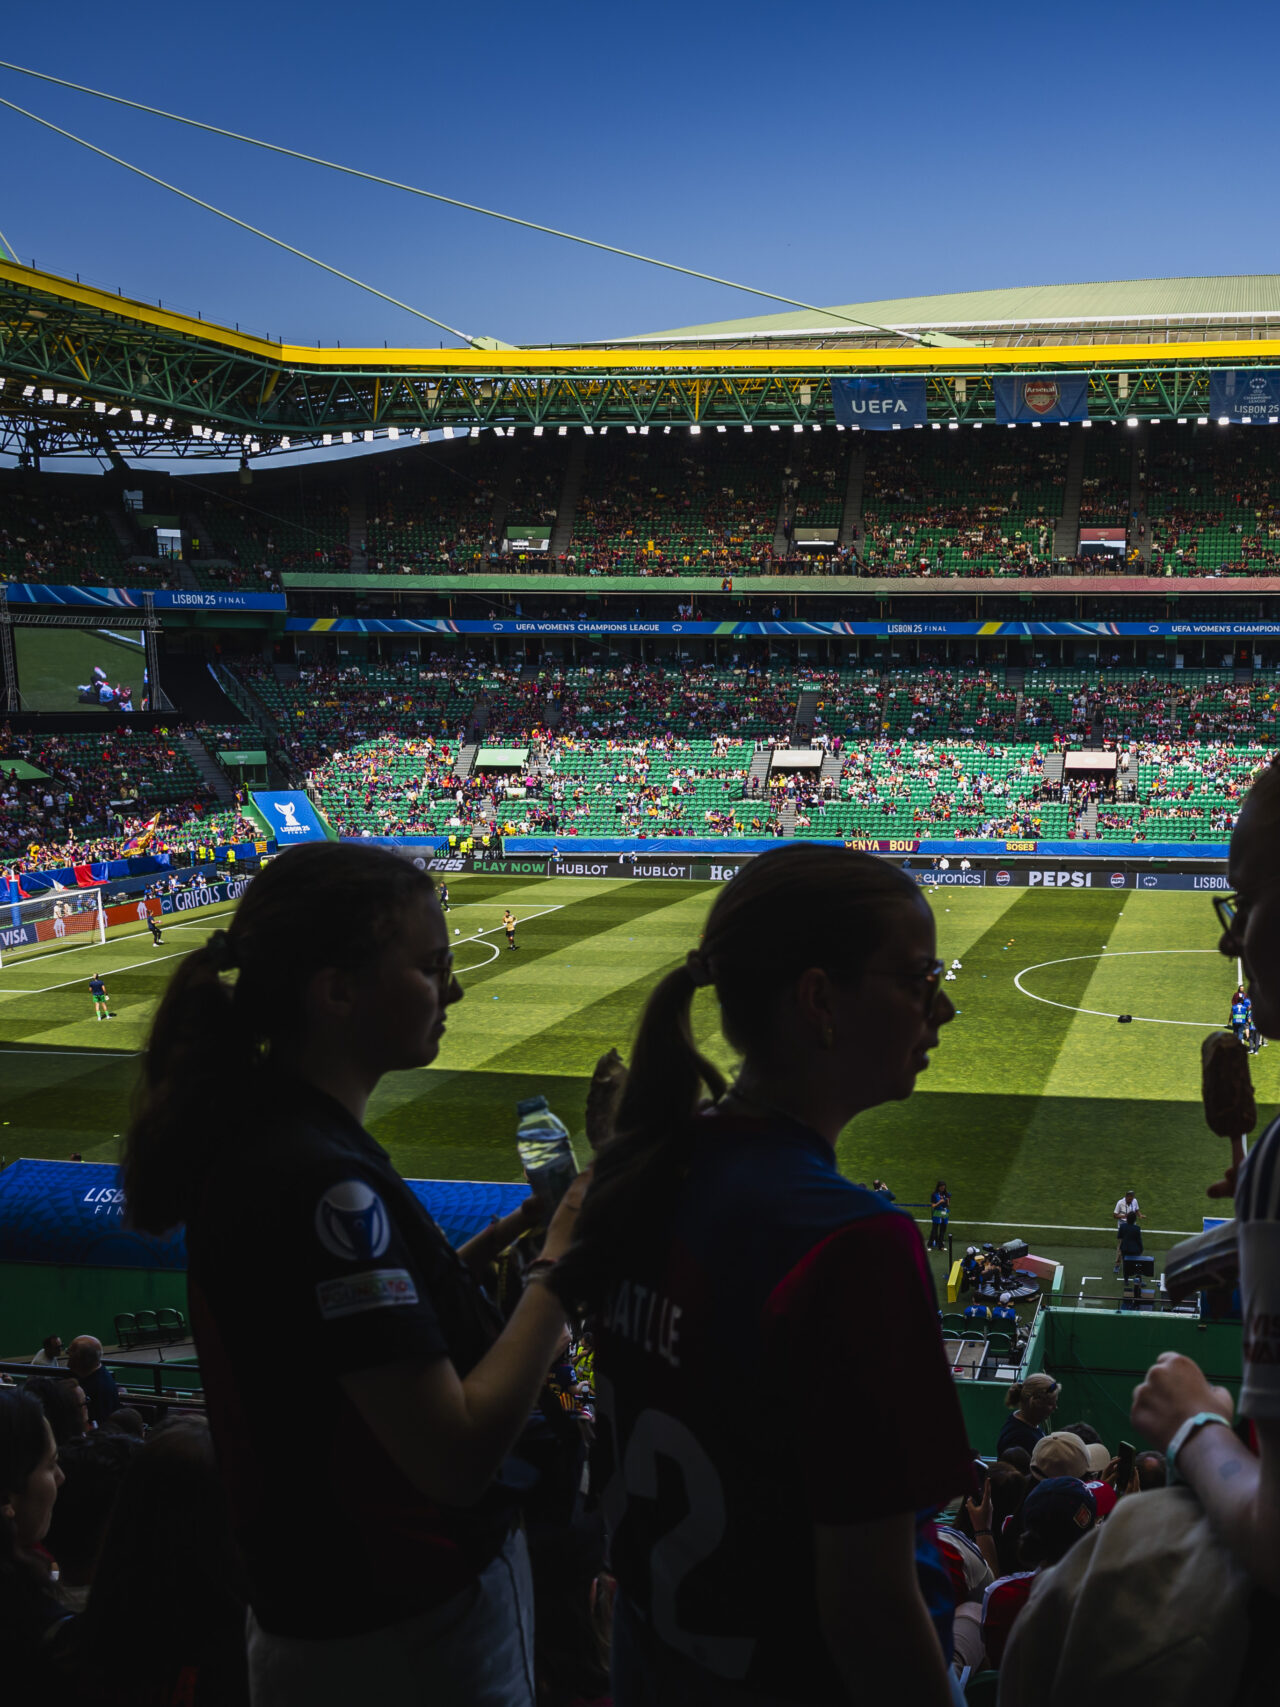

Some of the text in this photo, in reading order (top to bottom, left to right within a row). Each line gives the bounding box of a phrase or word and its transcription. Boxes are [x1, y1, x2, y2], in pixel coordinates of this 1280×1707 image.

[1026, 385, 1056, 394] Arsenal
[852, 399, 908, 414] UEFA
[1234, 405, 1280, 413] LISBON 25
[172, 594, 246, 605] LISBON 25 FINAL
[516, 623, 660, 632] UEFA WOMEN'S CHAMPIONS LEAGUE
[887, 624, 912, 633] LISBON
[913, 624, 922, 633] 25
[1171, 625, 1192, 633] UEFA
[1193, 625, 1231, 633] WOMEN'S
[889, 840, 913, 851] BOU
[1006, 843, 1034, 851] SOSES
[473, 861, 508, 872] PLAY
[510, 863, 545, 873] NOW
[556, 864, 609, 875] HUBLOT
[633, 866, 685, 877] HUBLOT
[923, 872, 981, 884] euronics
[1029, 871, 1091, 887] PEPSI
[175, 885, 220, 911] GRIFOLS
[0, 928, 28, 946] VISA
